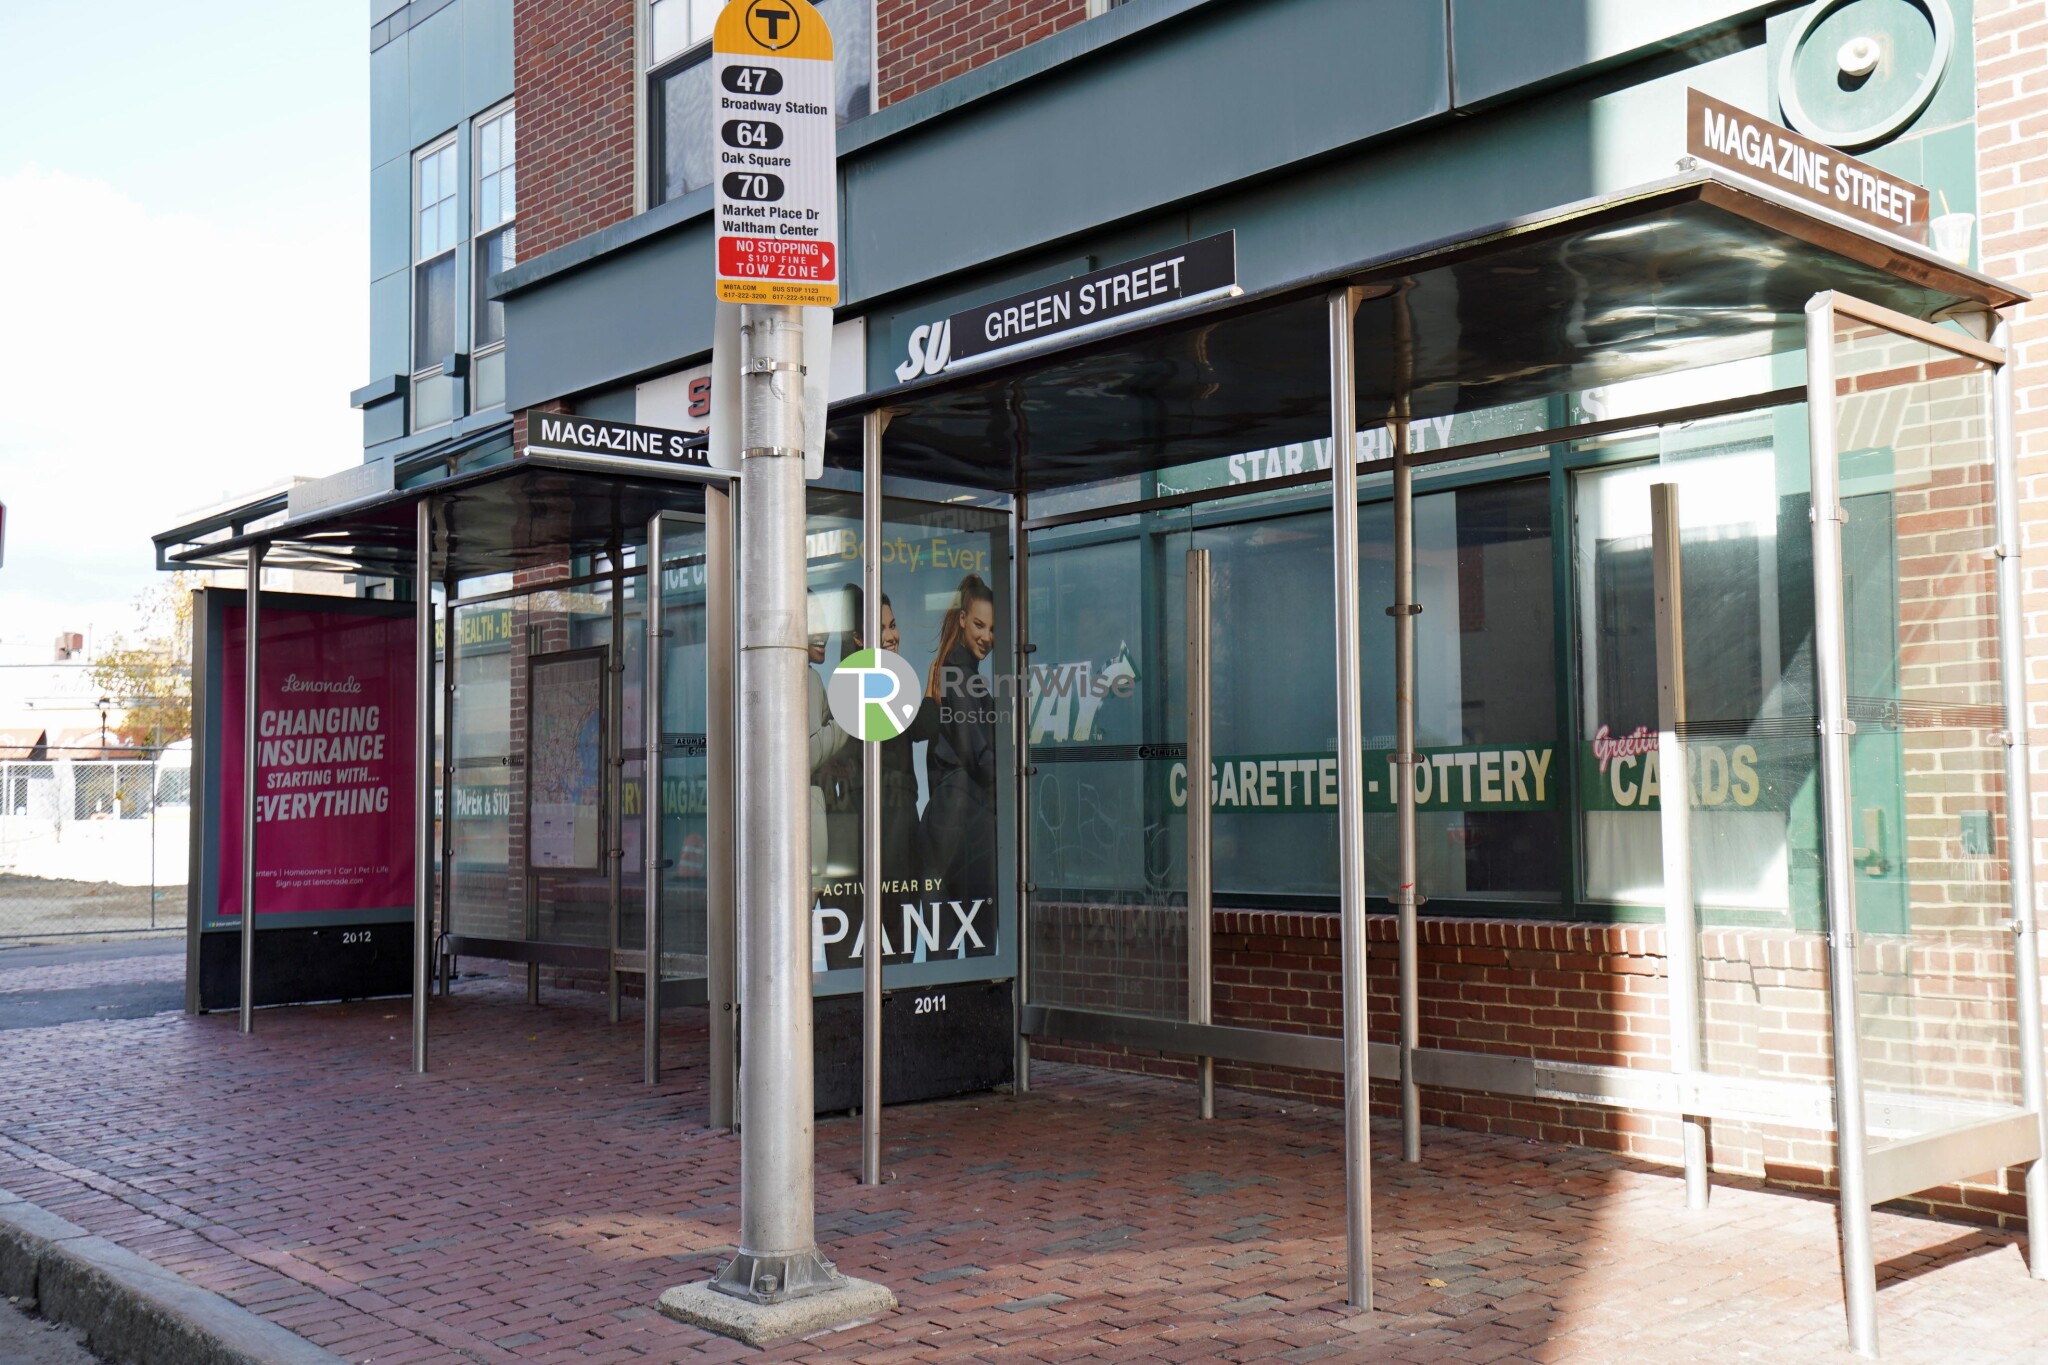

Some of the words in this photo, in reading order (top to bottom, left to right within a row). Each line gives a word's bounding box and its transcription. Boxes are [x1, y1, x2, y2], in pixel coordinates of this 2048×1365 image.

[736, 68, 768, 92] 47
[721, 97, 782, 114] Broadway
[785, 101, 828, 115] Station
[736, 122, 768, 147] 64
[721, 152, 745, 164] Oak
[748, 153, 791, 168] Square
[1704, 107, 1830, 195] MAGAZINE
[1835, 162, 1915, 226] STREET
[738, 174, 769, 199] 70
[722, 204, 766, 218] Market
[769, 206, 803, 219] Place
[806, 208, 820, 220] Dr
[722, 220, 776, 234] Waltham
[779, 223, 819, 236] Center
[736, 240, 754, 252] NO
[758, 241, 819, 256] STOPPING
[748, 253, 776, 263] $100
[781, 255, 807, 265] FINE
[736, 262, 769, 276] TOW
[777, 264, 819, 278] ZONE
[723, 291, 767, 300] 617-222-3200
[772, 294, 815, 302] 617-222-5146
[816, 295, 832, 303] (TTY)
[984, 291, 1070, 342] GREEN
[1079, 256, 1185, 315] STREET
[541, 419, 663, 456] MAGAZINE
[1229, 442, 1304, 485] STAR
[1313, 414, 1455, 470] VRITY
[931, 539, 990, 572] Ever.
[459, 614, 494, 644] HEALTH
[281, 674, 362, 693] Lemonade
[260, 706, 380, 737] CHANGING
[267, 769, 332, 789] STARTING
[336, 766, 380, 784] WITH...
[256, 786, 389, 823] EVERYTHING
[283, 867, 332, 877] Homeowners
[338, 867, 352, 875] Car
[358, 866, 370, 875] Pet
[376, 865, 389, 873] Life
[275, 880, 291, 889] Sign
[292, 880, 302, 888] up
[303, 879, 312, 887] at
[312, 877, 364, 887] lemonade.com
[823, 879, 919, 897] ACTIVWEAR
[925, 878, 943, 892] BY
[342, 931, 372, 944] 2012
[914, 994, 946, 1015] 2011
